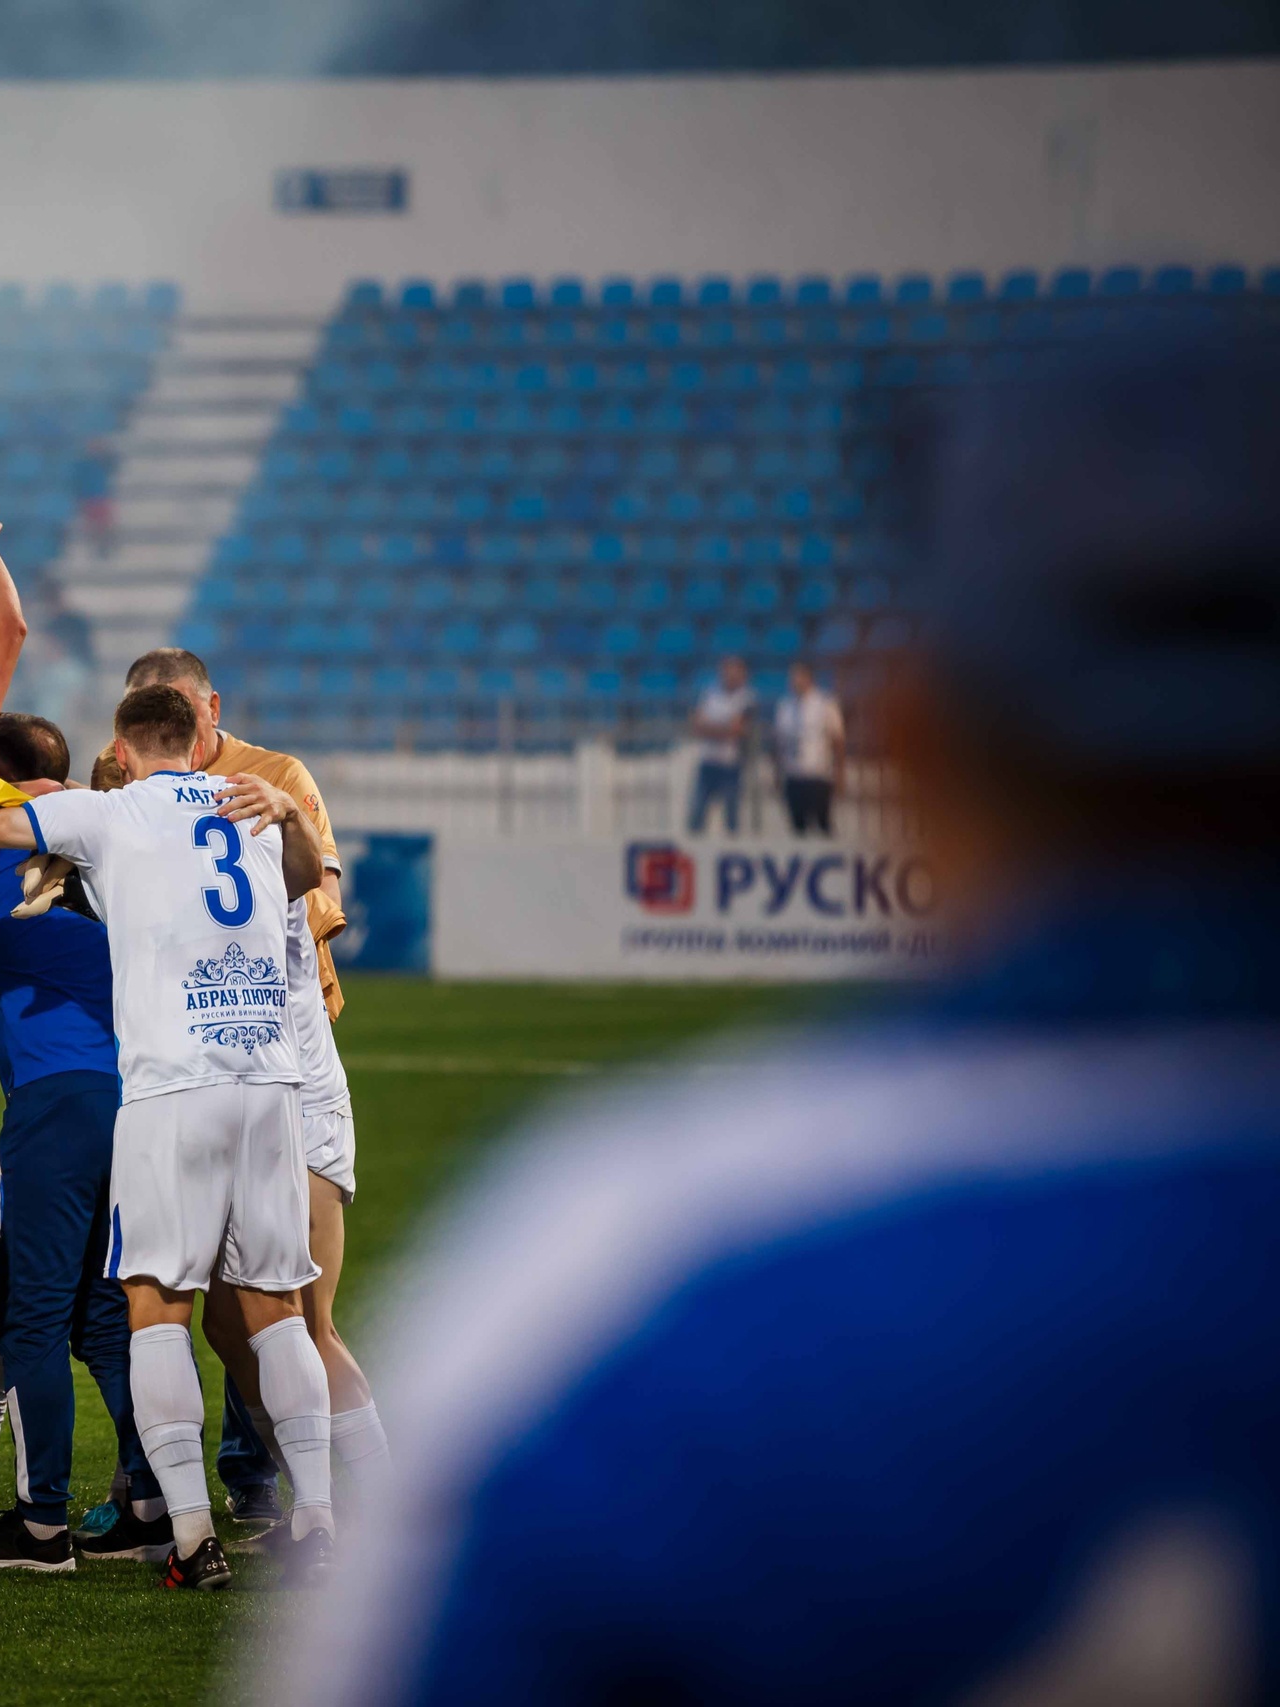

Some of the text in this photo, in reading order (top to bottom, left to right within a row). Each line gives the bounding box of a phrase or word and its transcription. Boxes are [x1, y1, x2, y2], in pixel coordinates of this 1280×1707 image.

[172, 787, 236, 805] ХАГУ
[192, 813, 257, 930] 3
[715, 854, 936, 919] РУСКО
[229, 976, 246, 986] 1870
[201, 1009, 236, 1020] РУССКИЙ
